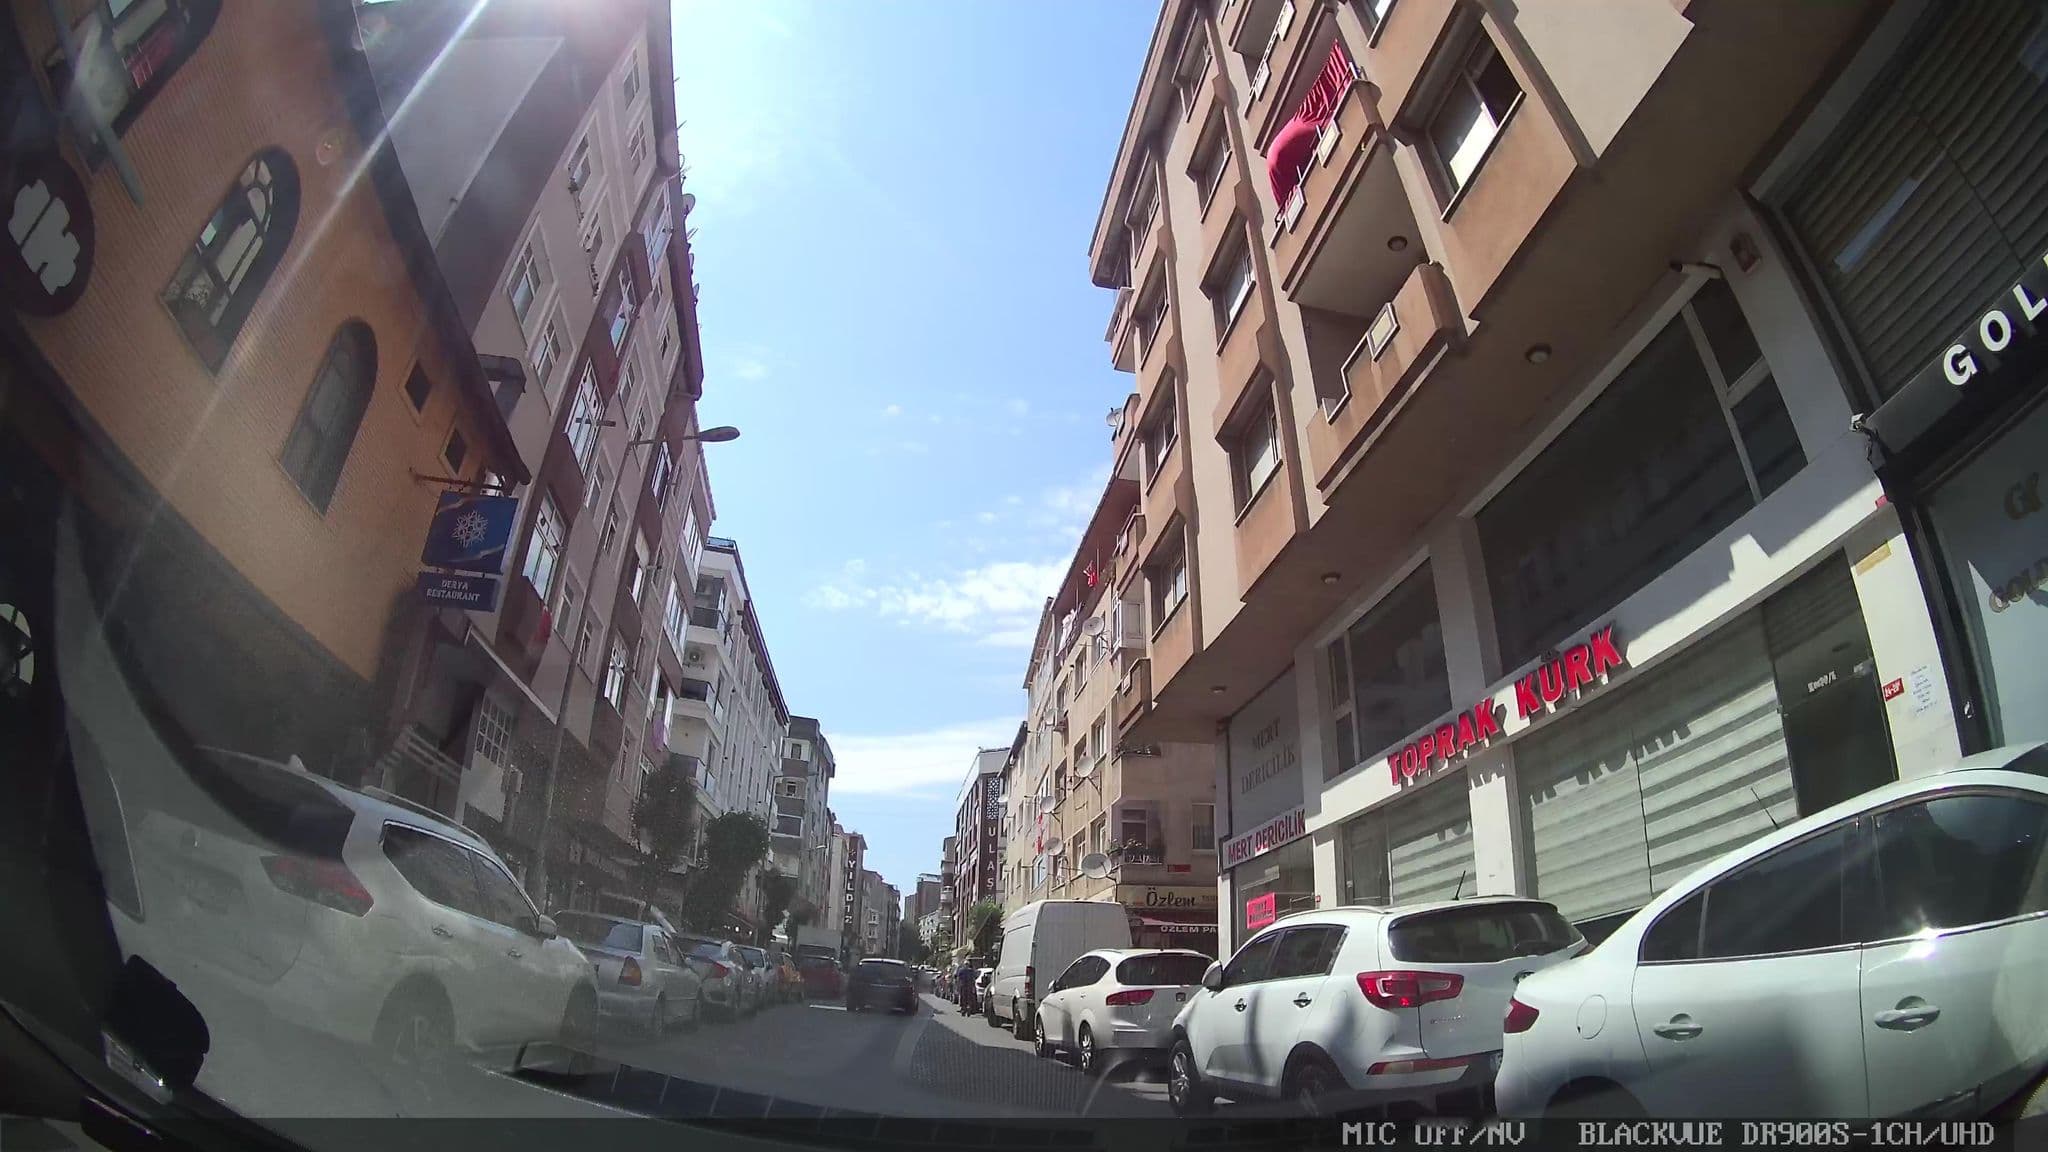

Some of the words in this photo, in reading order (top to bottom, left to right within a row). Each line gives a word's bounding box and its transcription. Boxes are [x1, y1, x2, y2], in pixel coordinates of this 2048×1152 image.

[1943, 252, 2048, 387] GOL
[427, 588, 480, 602] RESTAURANT
[441, 580, 469, 591] DERYA
[1387, 696, 1499, 786] TOPRAK
[1228, 834, 1253, 865] MERT
[1146, 887, 1197, 908] Özlem
